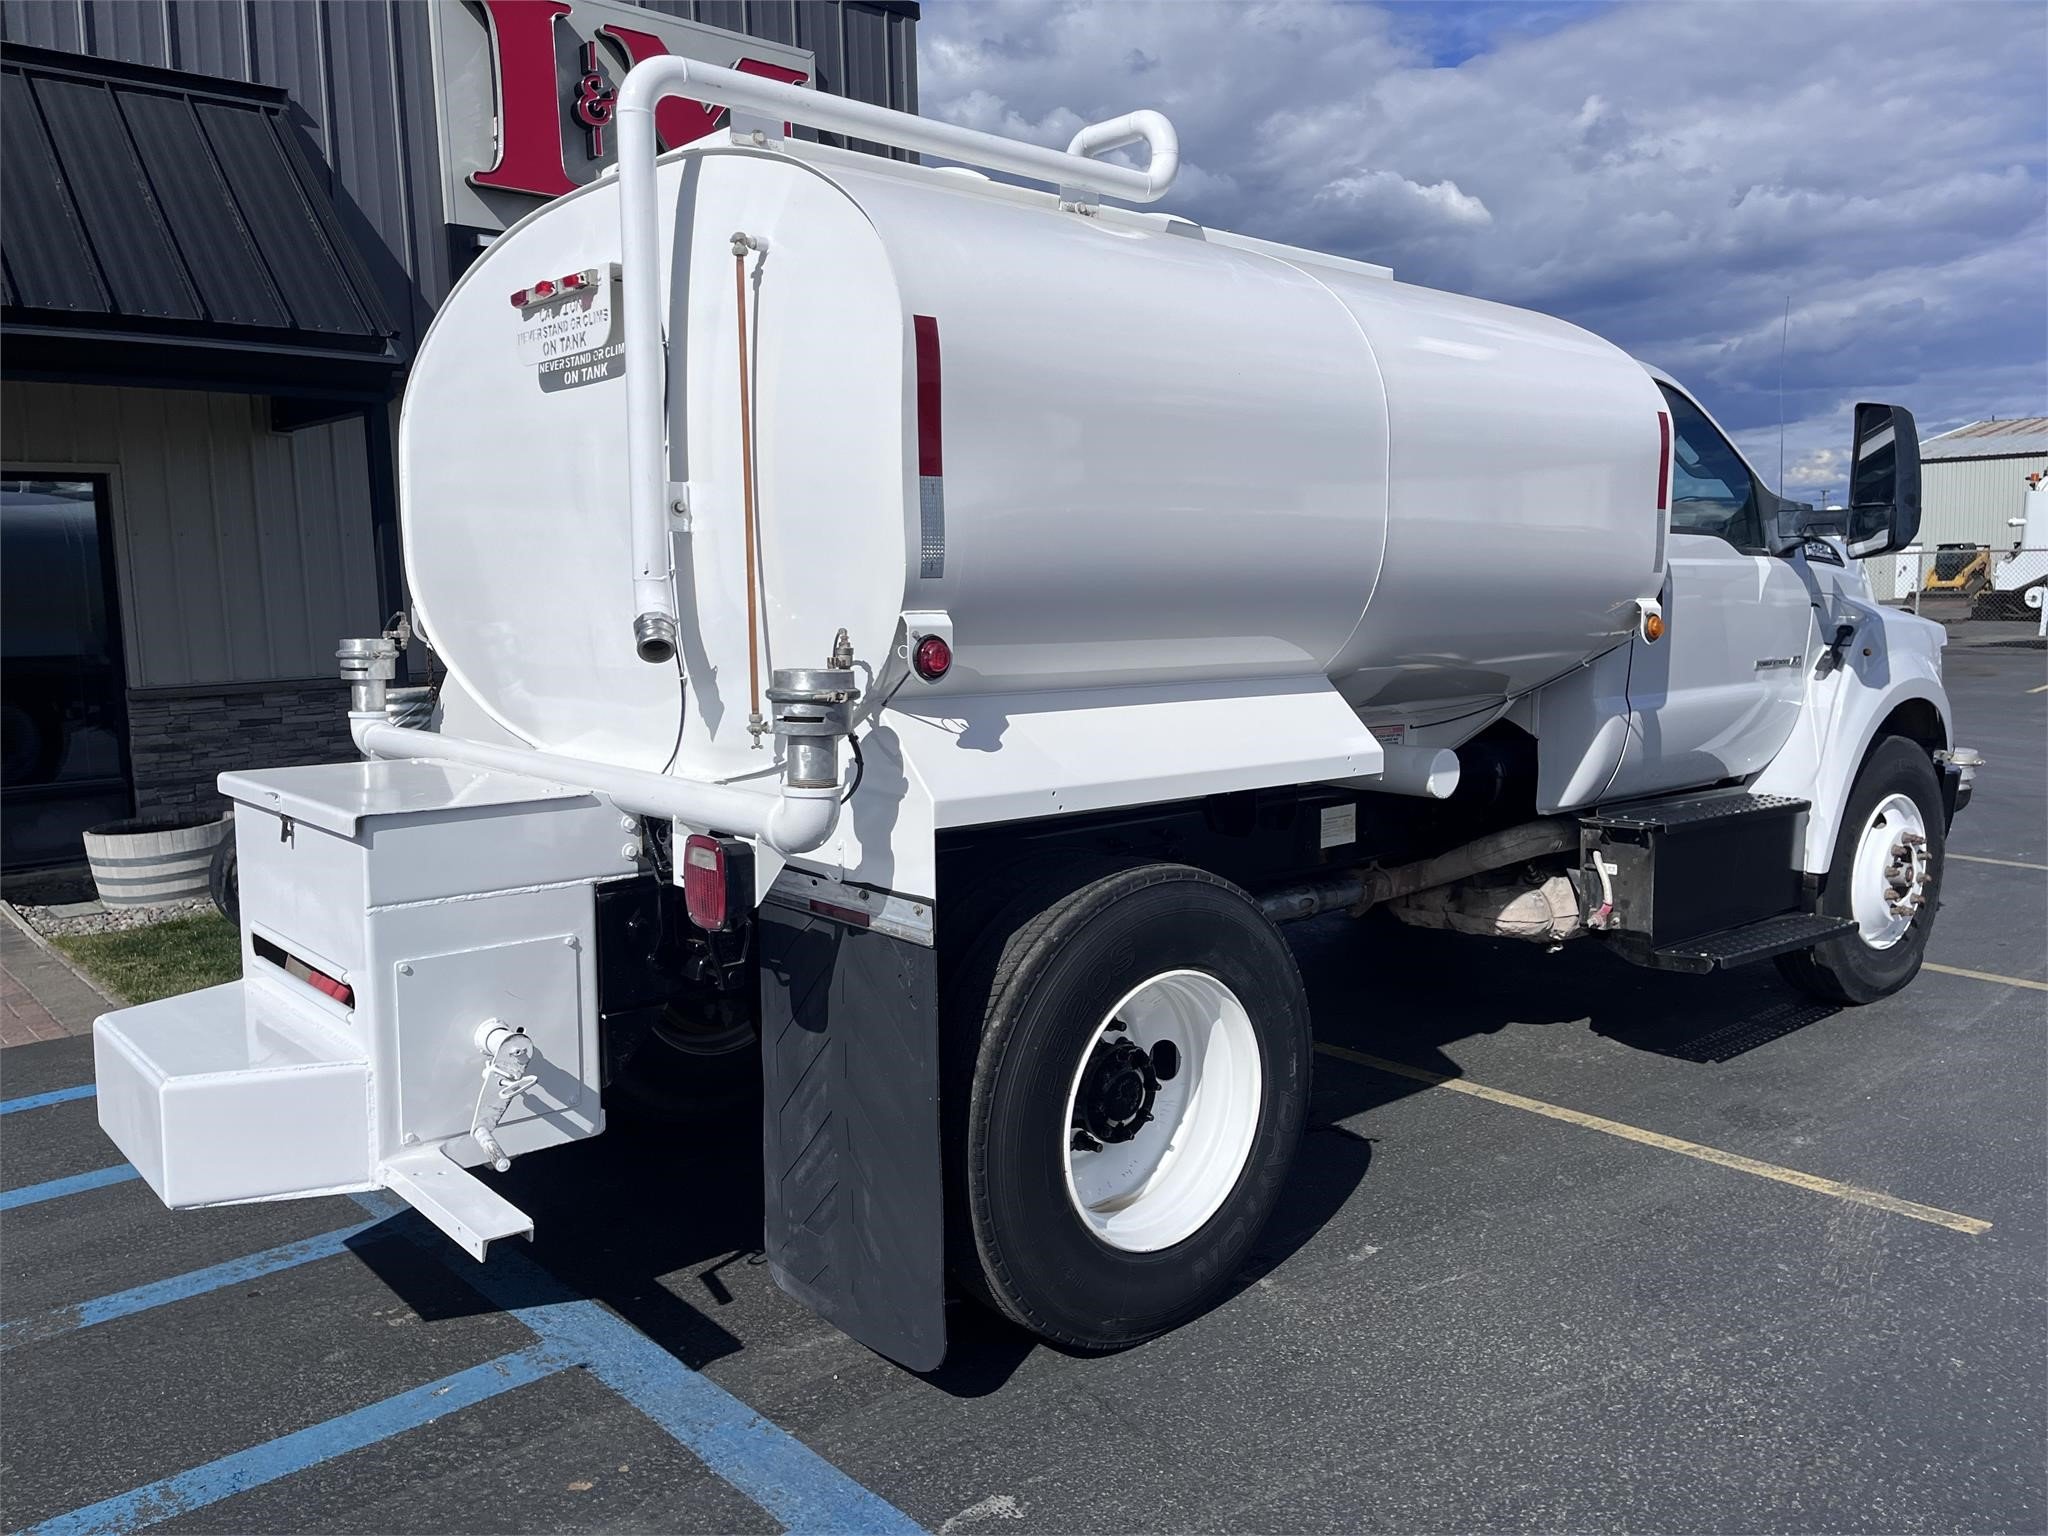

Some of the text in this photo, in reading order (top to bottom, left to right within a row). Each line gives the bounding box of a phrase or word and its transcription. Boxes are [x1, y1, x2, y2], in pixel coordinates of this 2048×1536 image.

[543, 320, 569, 338] STAND
[570, 316, 581, 330] OR
[543, 331, 587, 356] ON TANK
[539, 343, 626, 374] NEVER STAND OR CLIM
[564, 362, 609, 385] ON TANK
